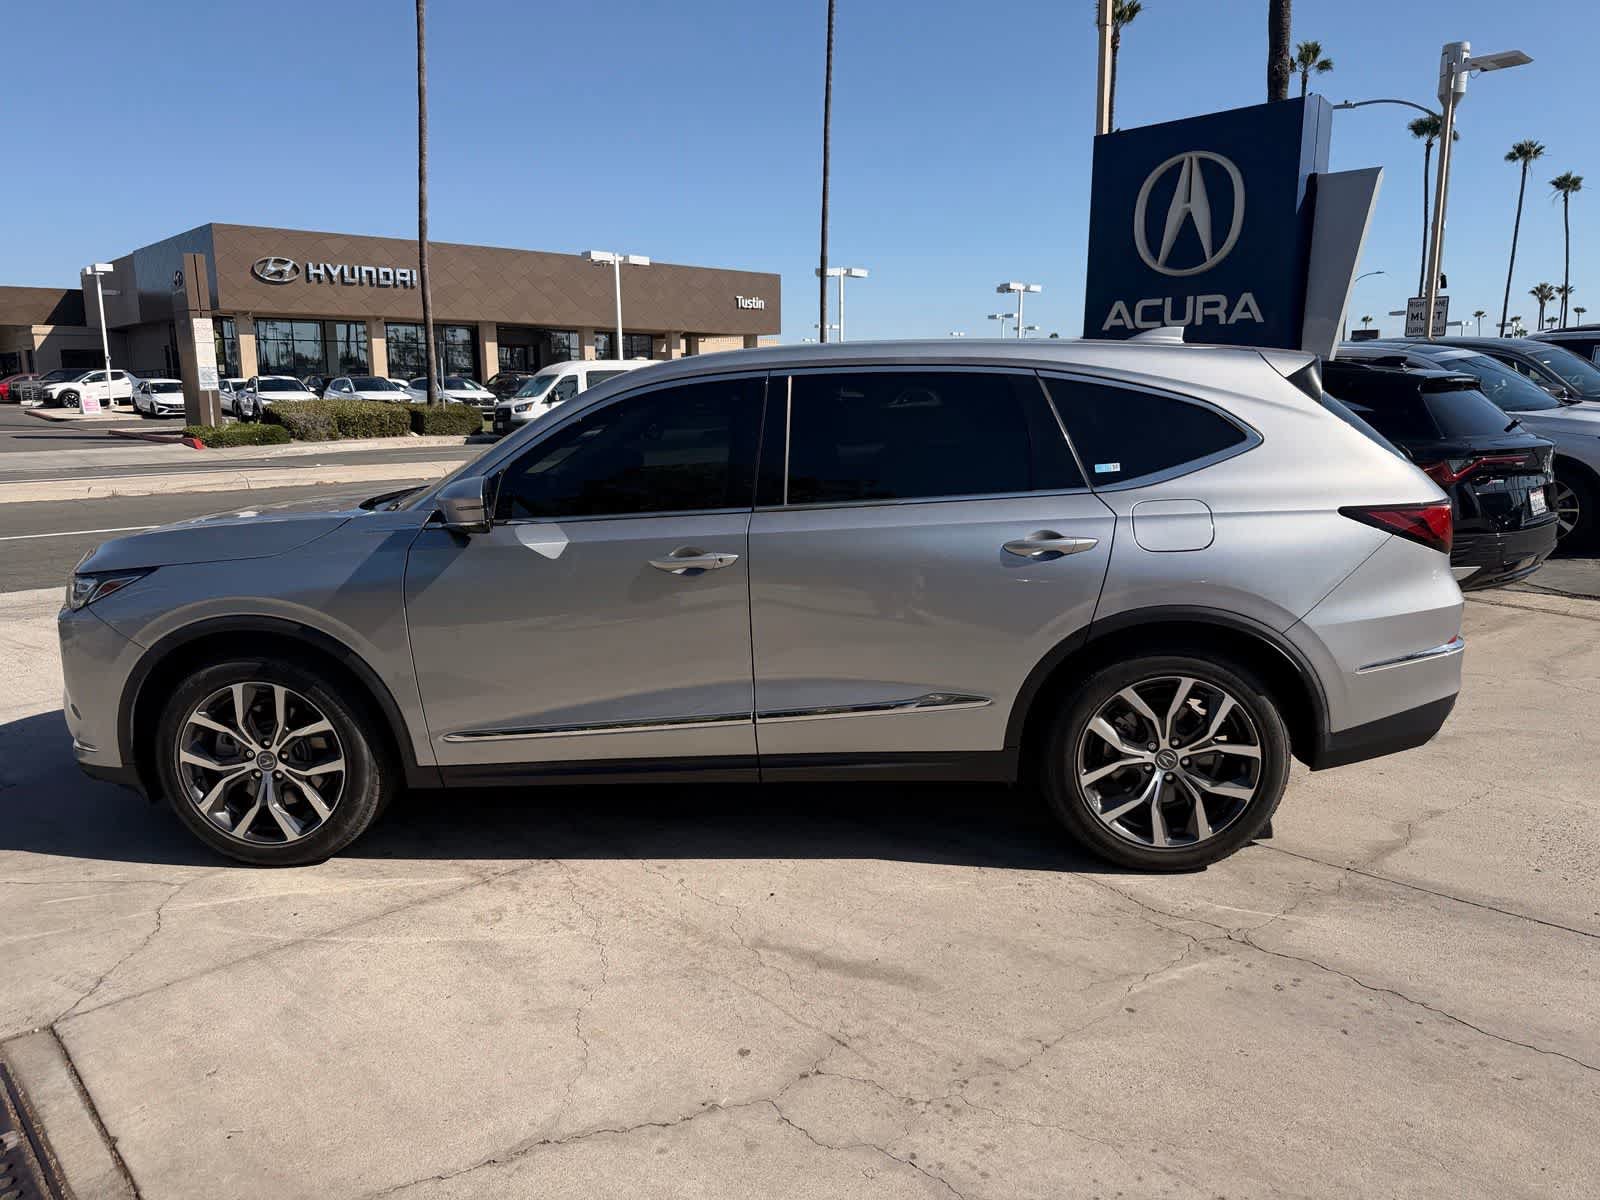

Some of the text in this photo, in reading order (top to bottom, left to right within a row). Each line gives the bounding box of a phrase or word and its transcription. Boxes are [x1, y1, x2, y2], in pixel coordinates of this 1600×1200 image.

[306, 262, 417, 288] HYUNDAI
[736, 296, 765, 310] Tustin
[1101, 292, 1265, 331] ACURA
